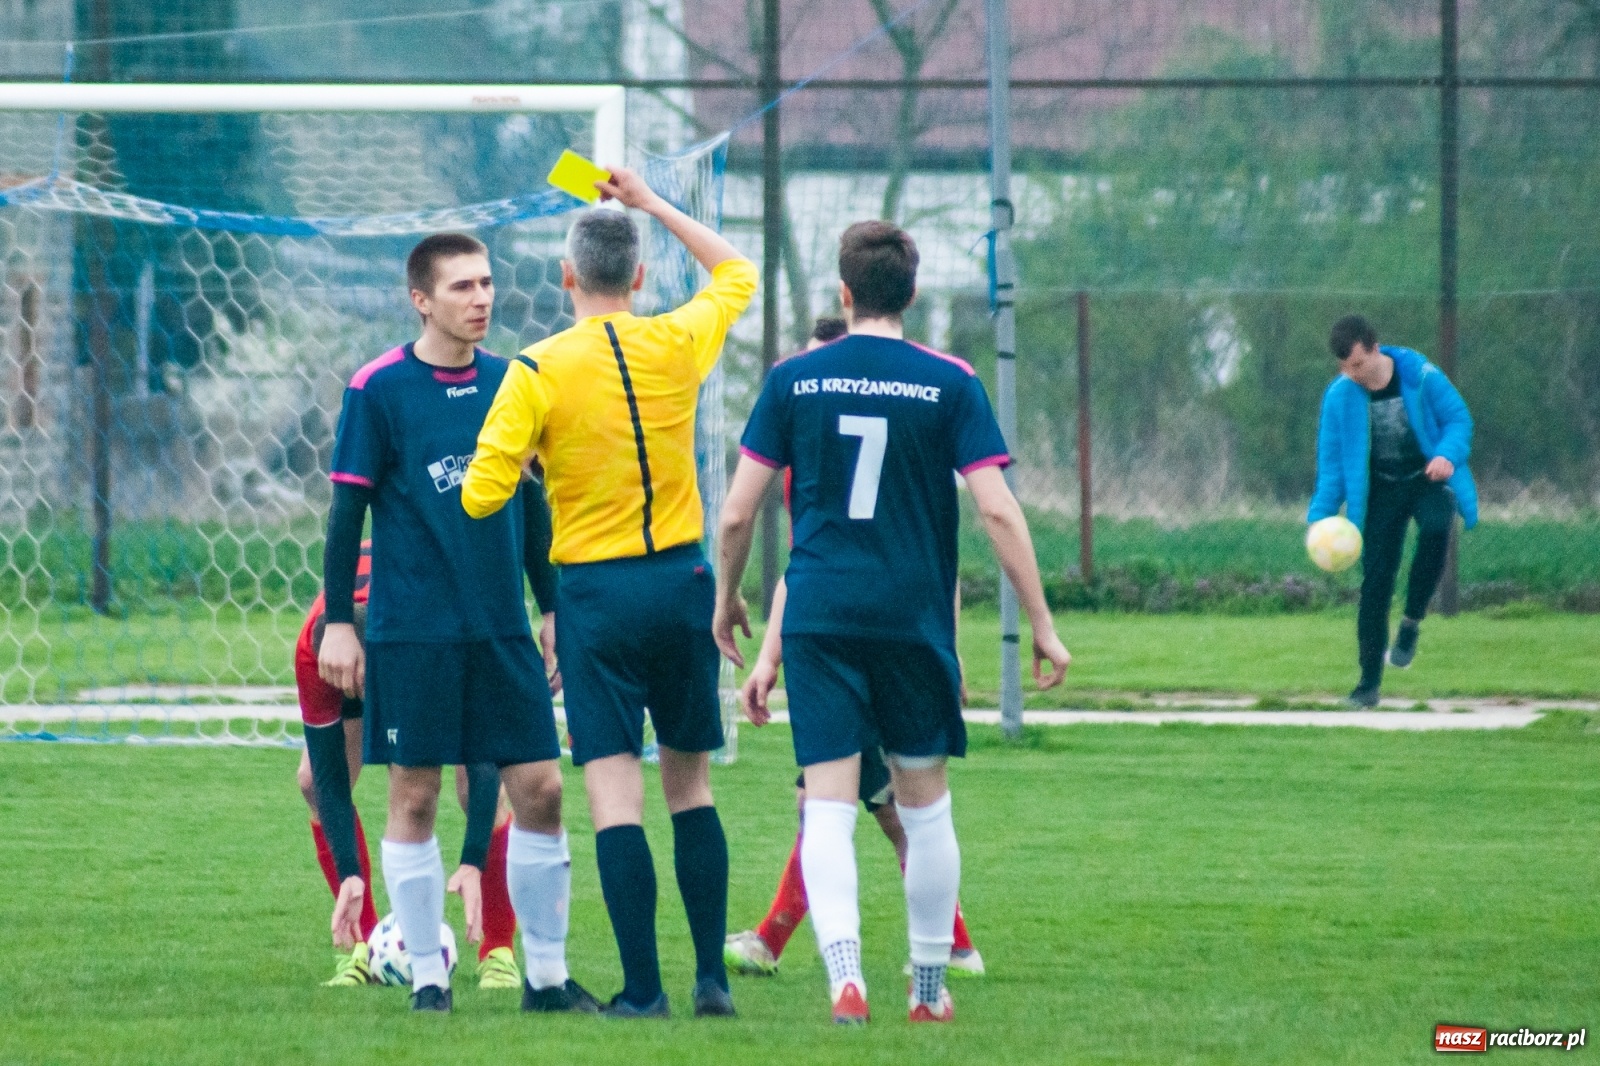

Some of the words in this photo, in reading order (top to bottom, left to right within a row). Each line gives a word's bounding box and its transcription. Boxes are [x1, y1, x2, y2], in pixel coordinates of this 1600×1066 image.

[793, 378, 819, 396] LKS
[822, 377, 941, 403] KRZYŻANOWICE
[838, 414, 889, 520] 7
